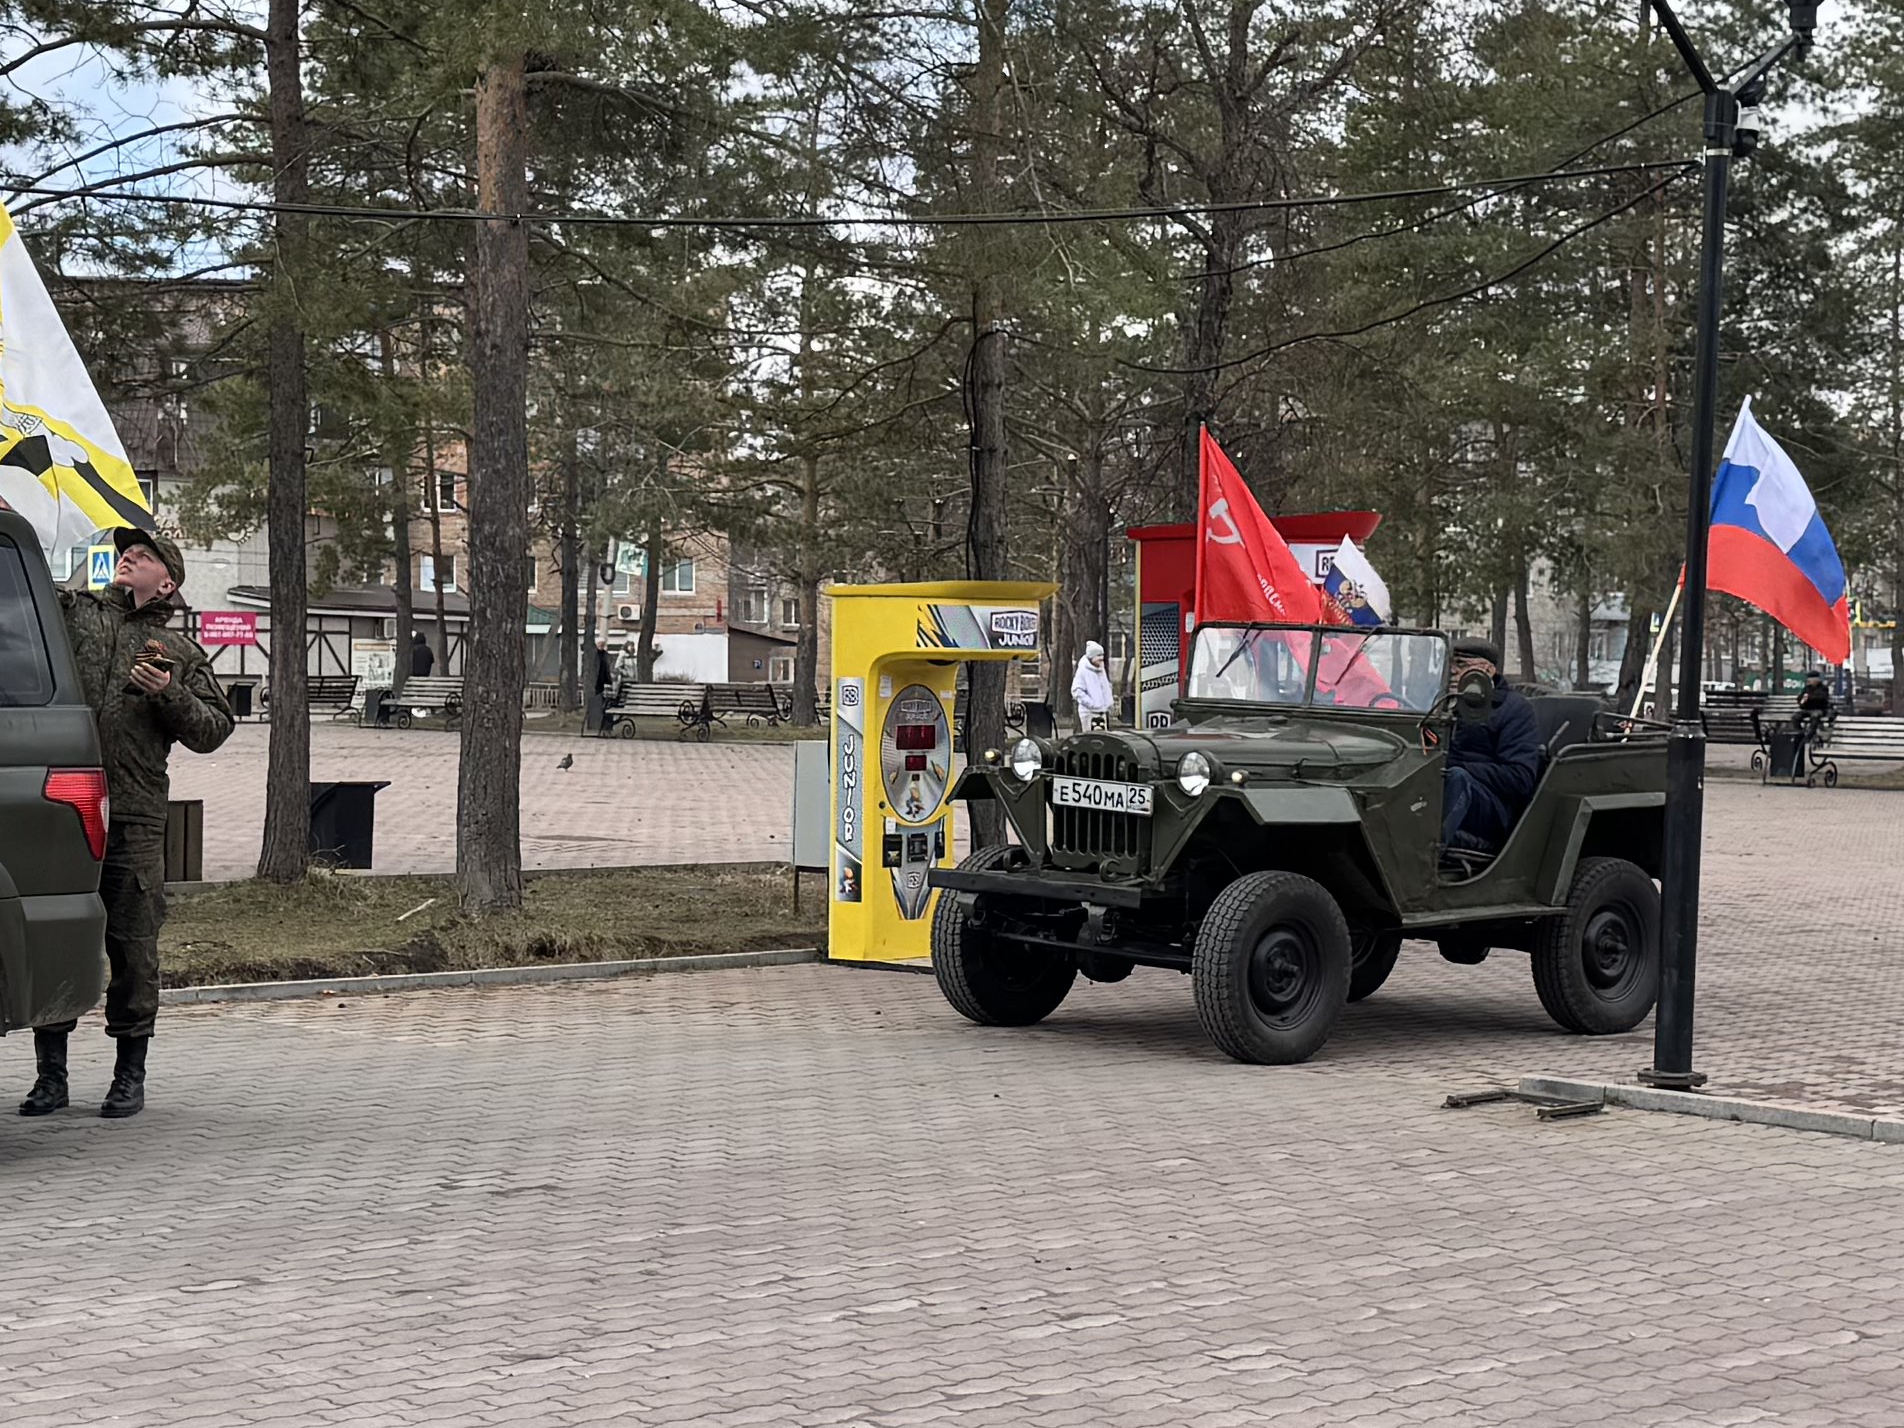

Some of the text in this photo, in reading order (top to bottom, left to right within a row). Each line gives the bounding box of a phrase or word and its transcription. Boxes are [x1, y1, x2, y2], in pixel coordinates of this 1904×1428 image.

[843, 735, 856, 842] JUNIOR
[1059, 782, 1146, 808] Е540МА 25
